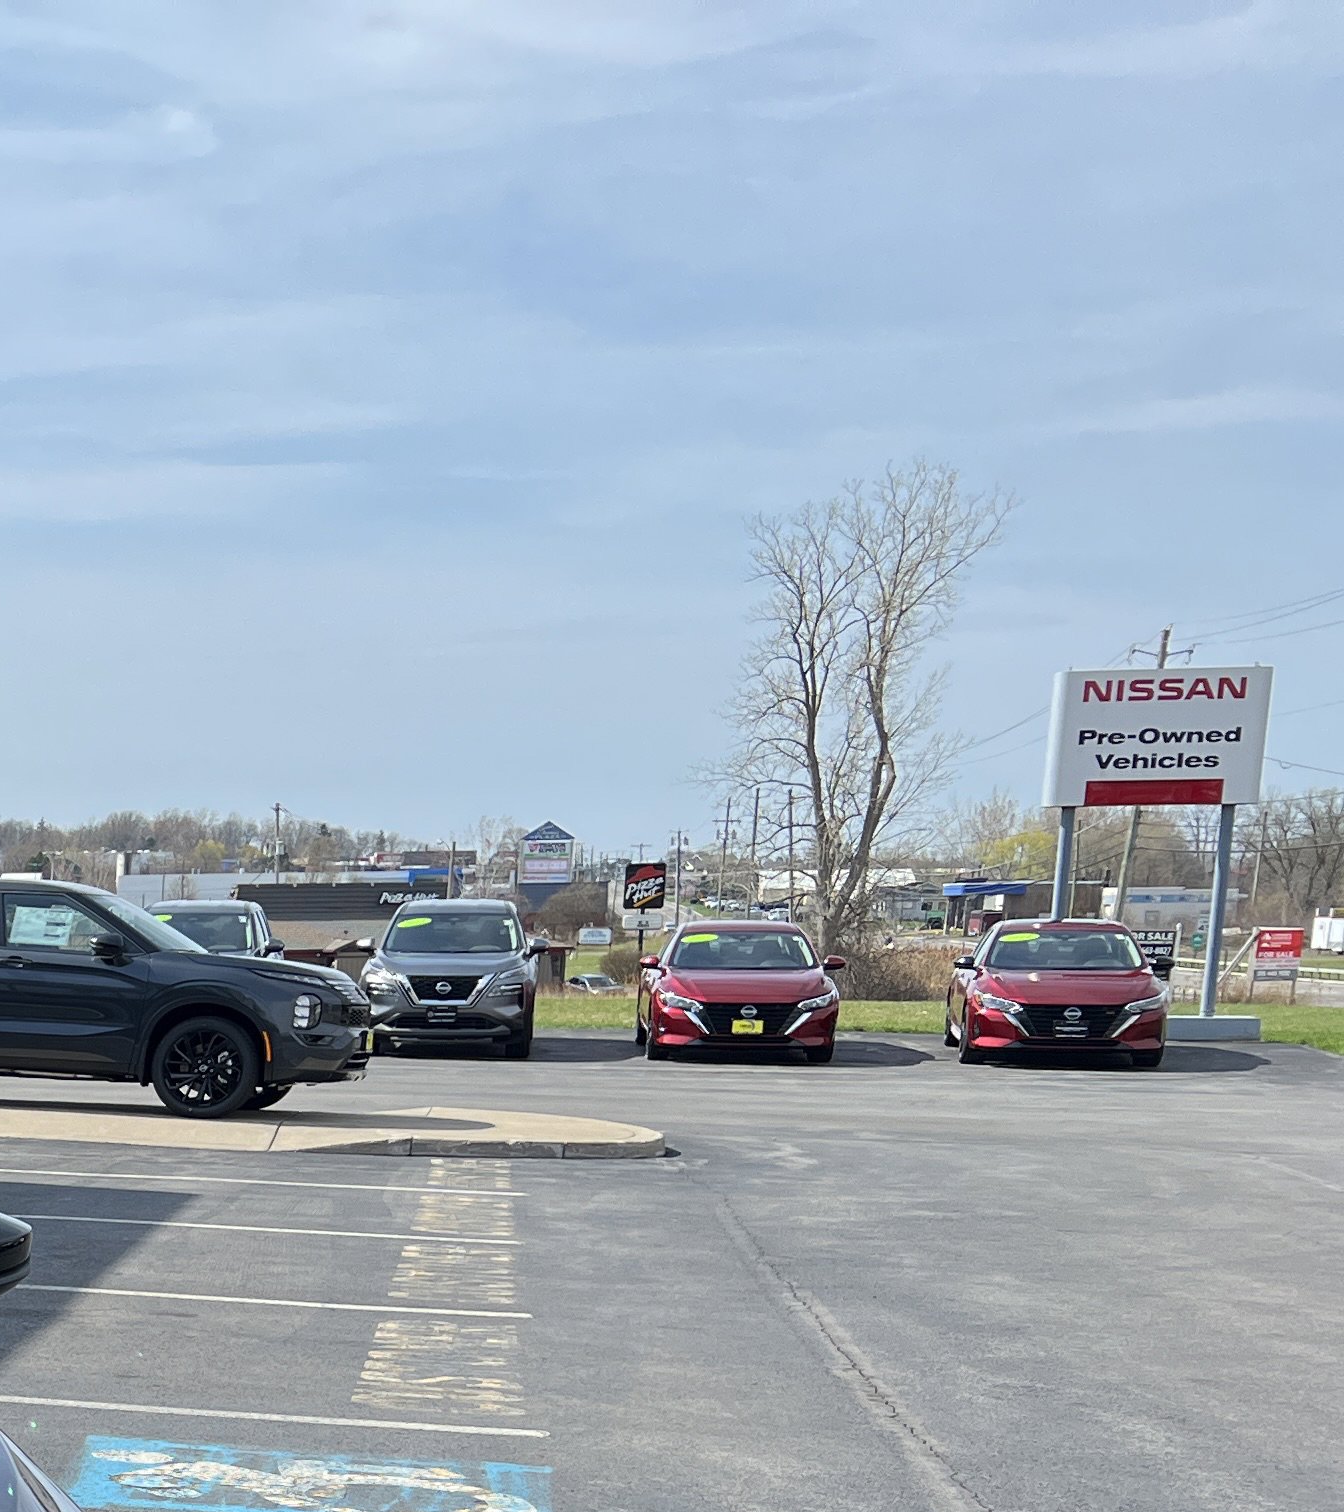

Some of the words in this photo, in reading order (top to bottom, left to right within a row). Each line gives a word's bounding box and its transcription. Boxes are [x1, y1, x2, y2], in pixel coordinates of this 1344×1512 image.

[1082, 676, 1248, 702] NISSAN
[1078, 726, 1242, 745] Pre-Owned
[1095, 753, 1220, 770] Vehicles
[625, 877, 664, 900] Pizza
[632, 885, 661, 904] Hut
